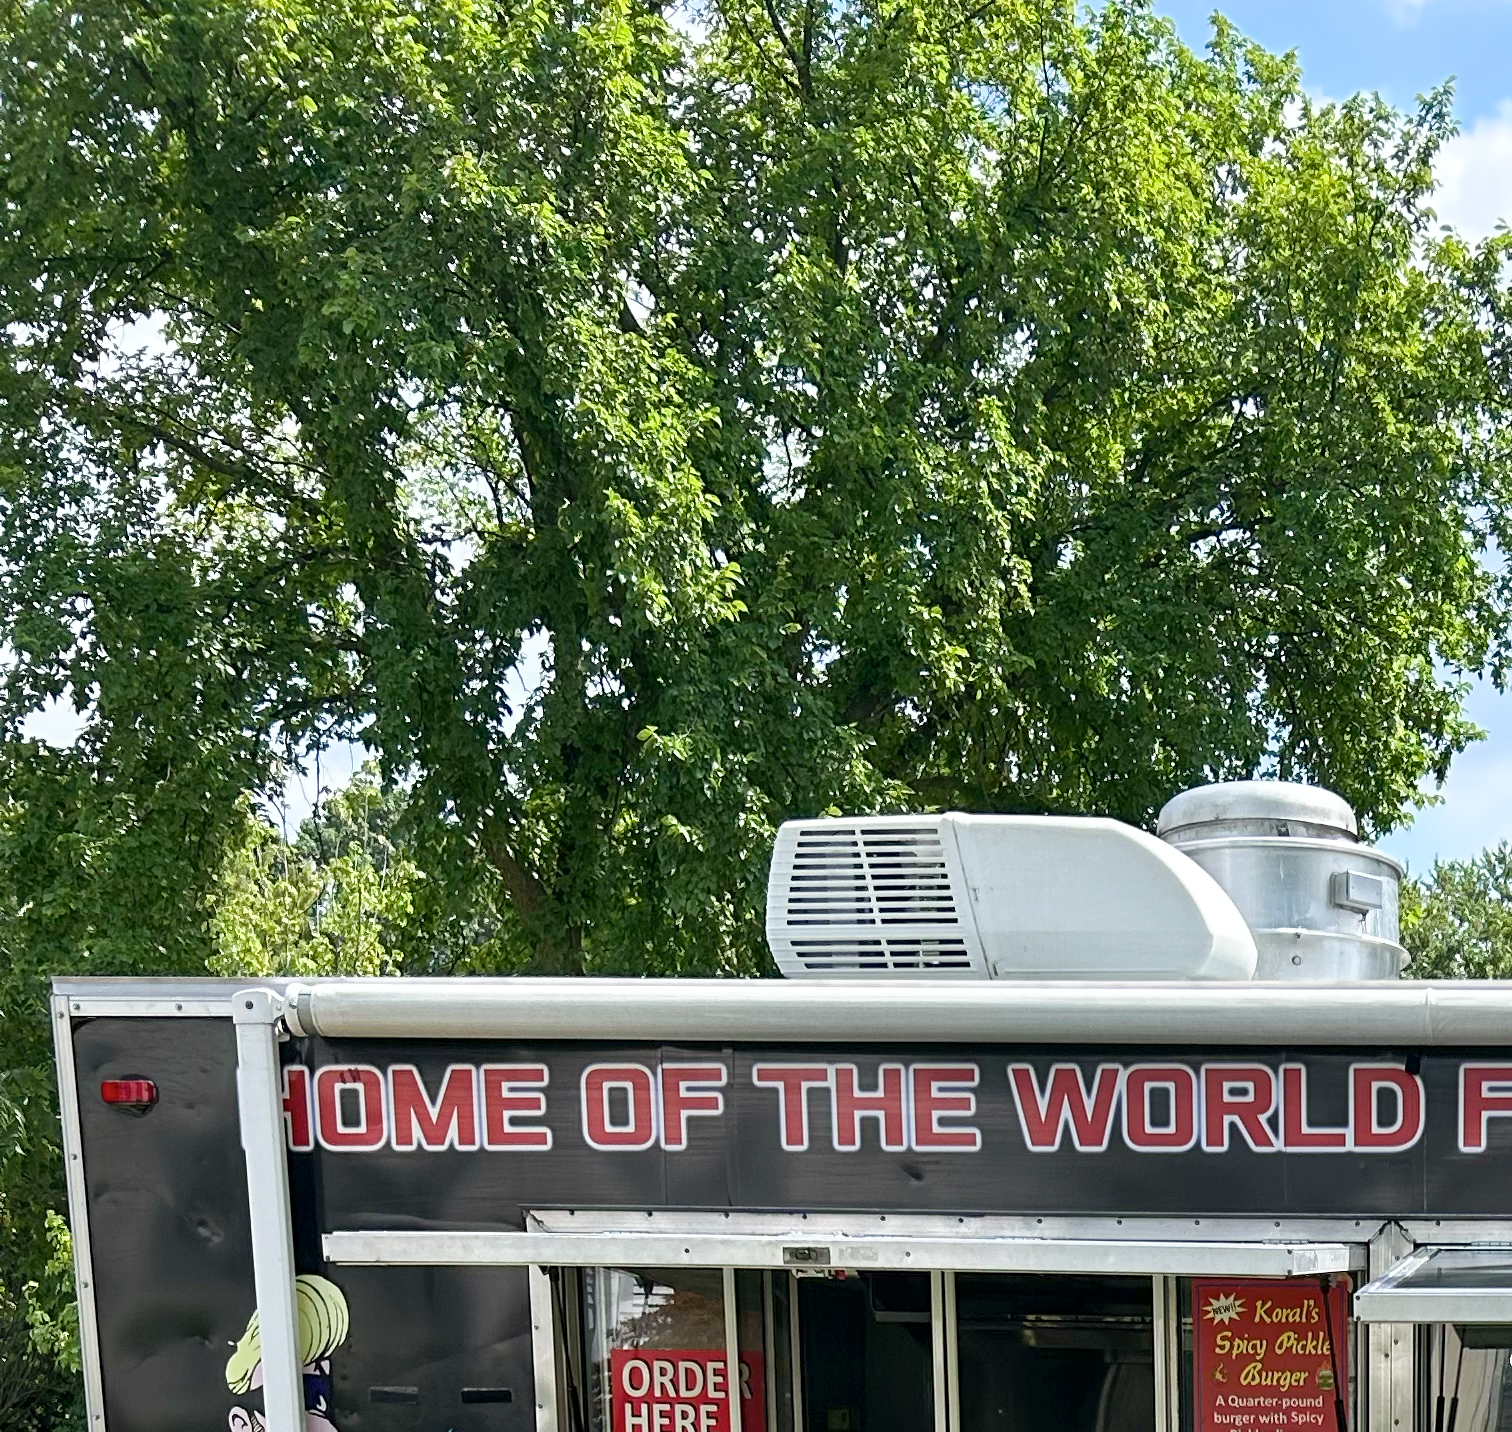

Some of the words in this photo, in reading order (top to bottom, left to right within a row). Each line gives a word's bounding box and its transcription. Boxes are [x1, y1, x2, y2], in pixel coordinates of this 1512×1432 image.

[581, 1063, 727, 1152] OF
[754, 1063, 981, 1152] THE
[1007, 1062, 1427, 1153] WORLD
[1254, 1299, 1319, 1324] Koral's
[1215, 1331, 1267, 1360] Spicy
[1275, 1331, 1331, 1355] Pickle
[1240, 1362, 1309, 1392] Burger
[1215, 1395, 1226, 1407] A
[1228, 1394, 1324, 1410] Quarter-pound
[1213, 1411, 1256, 1427] burger
[1259, 1411, 1288, 1425] with
[1290, 1410, 1325, 1427] Spicy
